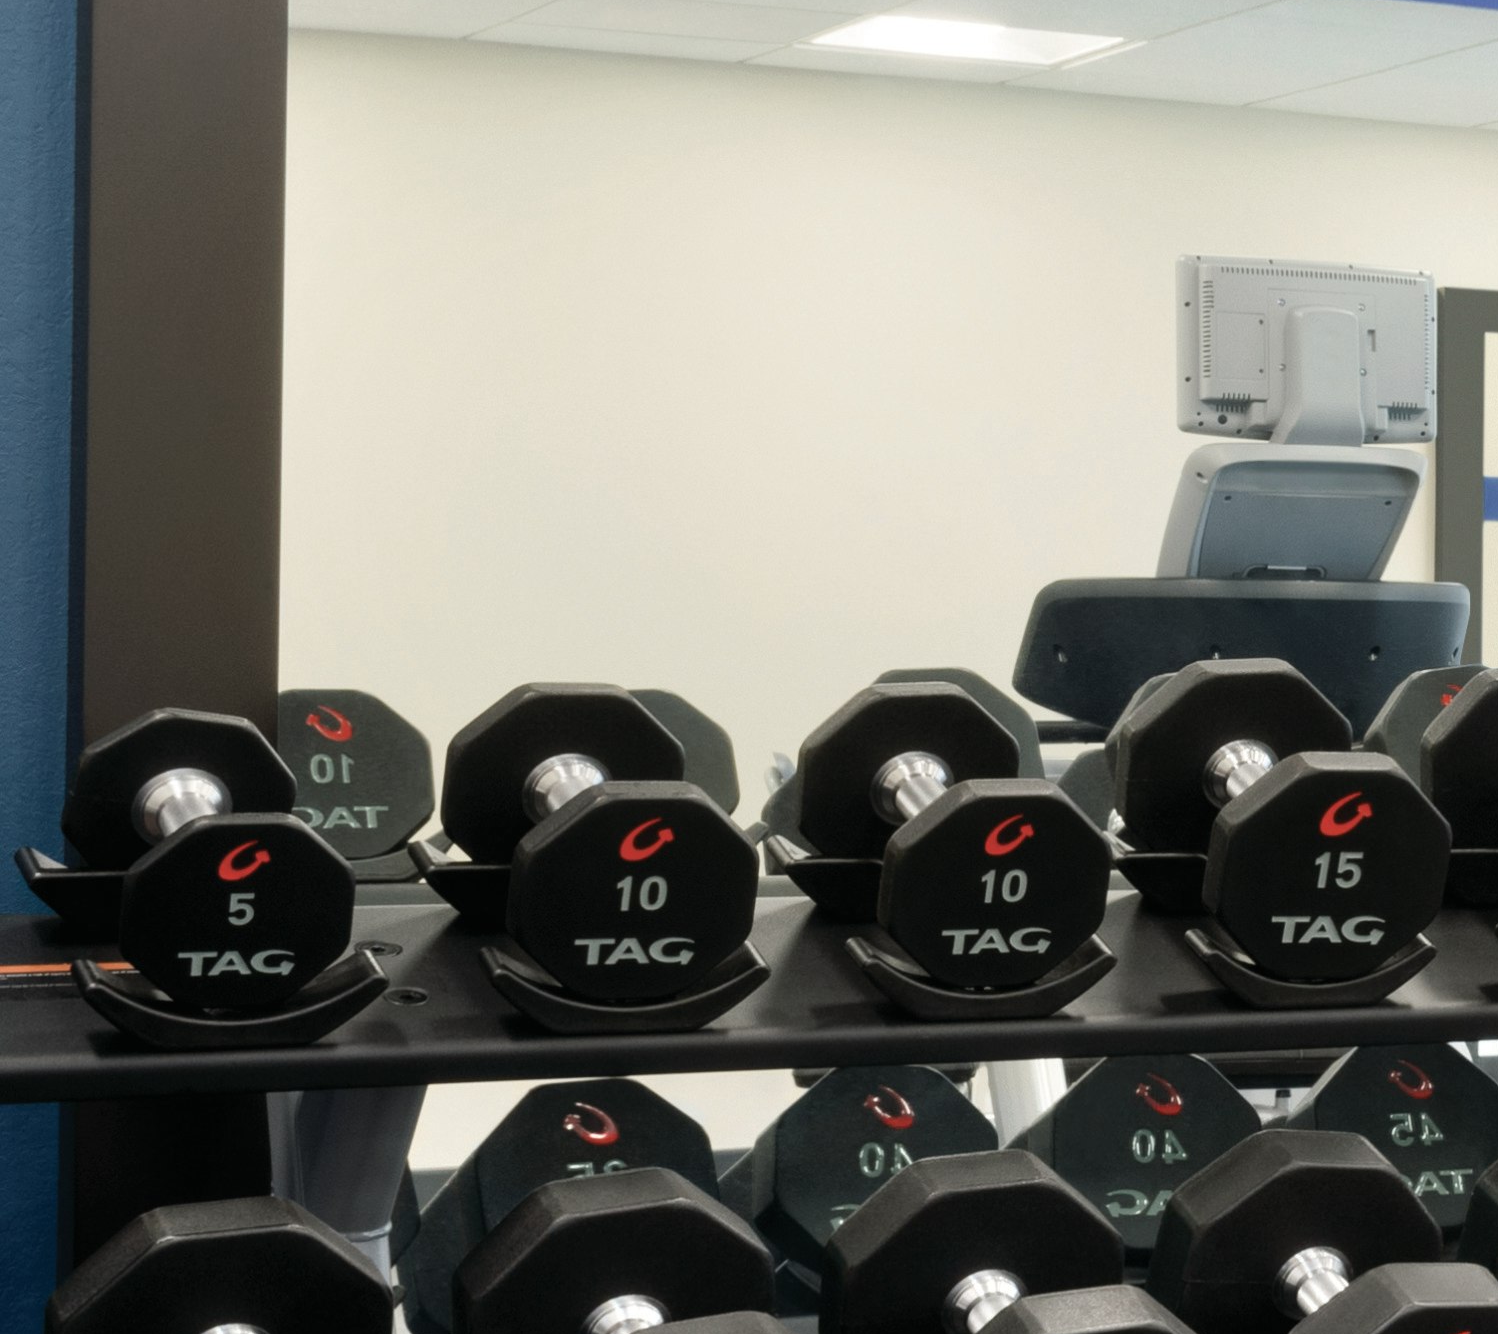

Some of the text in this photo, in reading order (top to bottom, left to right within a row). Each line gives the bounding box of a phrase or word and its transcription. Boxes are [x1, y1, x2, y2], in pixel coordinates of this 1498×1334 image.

[981, 868, 1028, 904] 10
[1314, 851, 1364, 889] 15
[227, 892, 256, 926] 5
[616, 875, 668, 912] 10
[941, 926, 1052, 956] TAG
[1271, 915, 1386, 946] TAG
[177, 949, 295, 977] TAG
[573, 936, 695, 966] TAG
